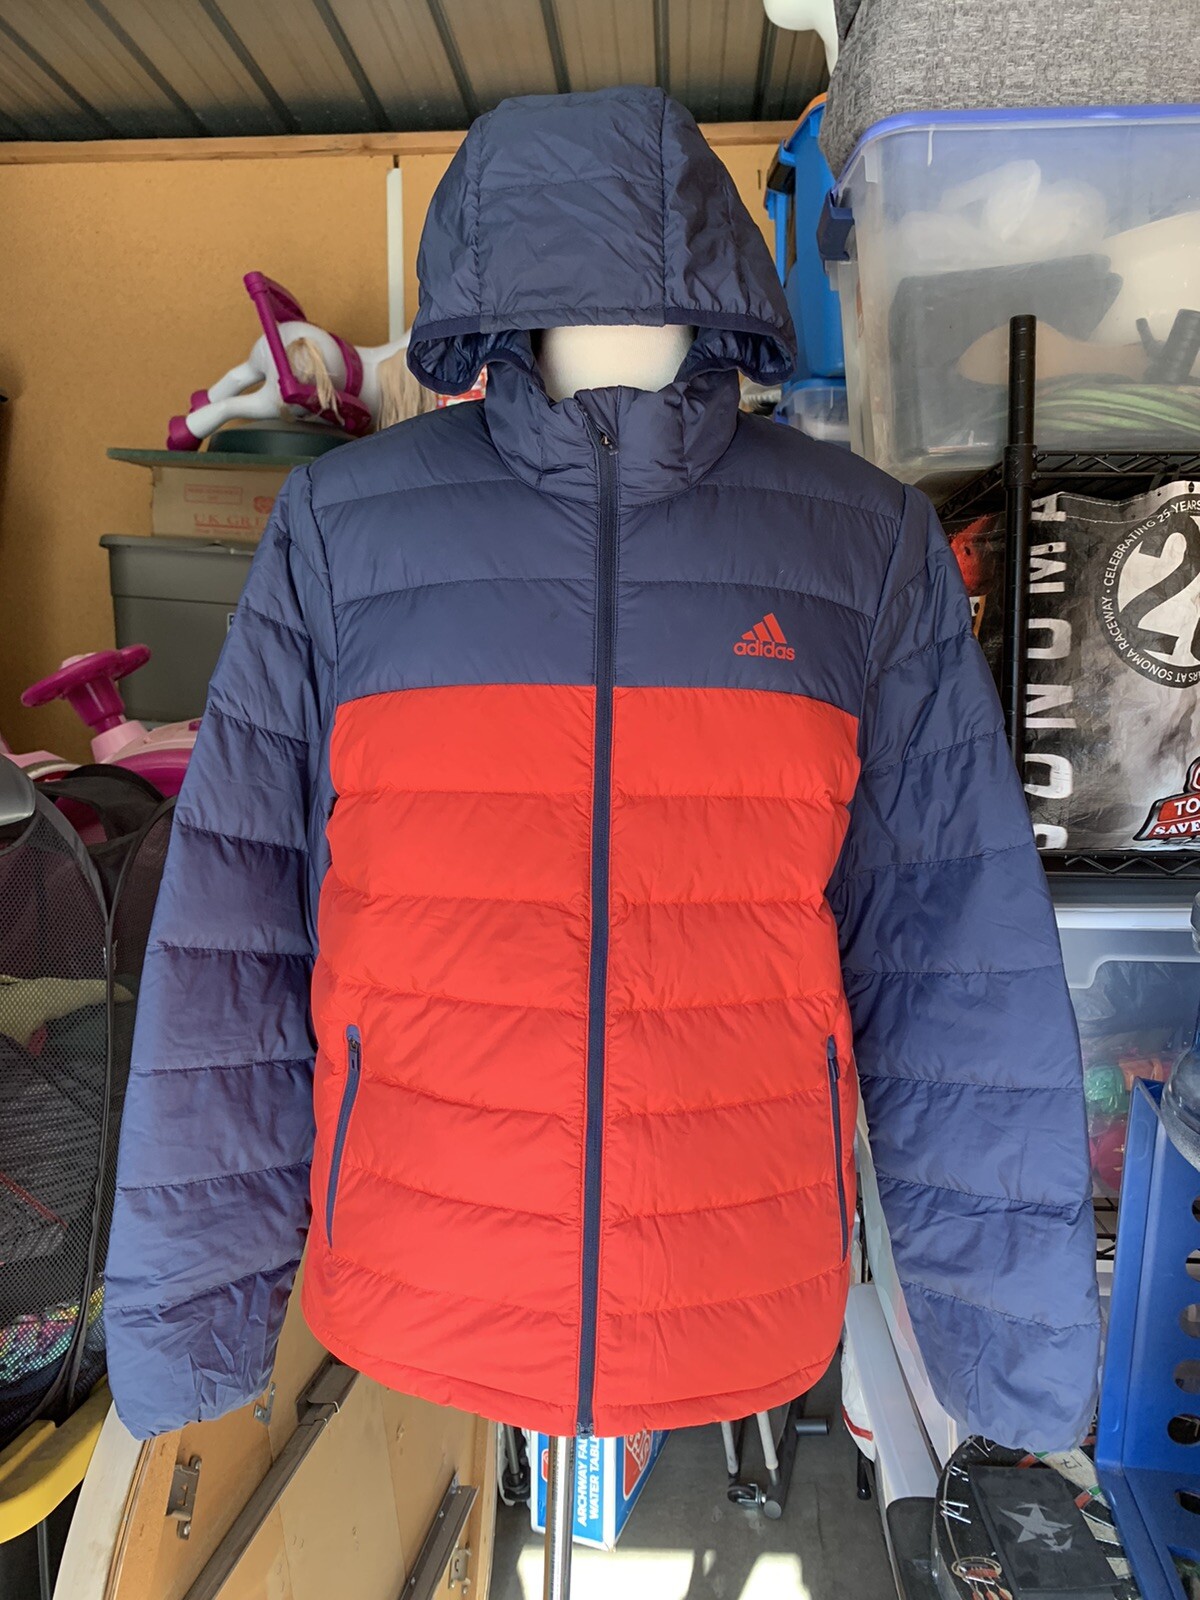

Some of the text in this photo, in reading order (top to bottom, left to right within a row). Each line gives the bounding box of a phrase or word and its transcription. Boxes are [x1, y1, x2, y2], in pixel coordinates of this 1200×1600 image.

[1103, 499, 1200, 586] CELEBRATING 25 YEARS
[1101, 596, 1130, 651] RACEWAY
[733, 640, 796, 661] adidas
[1126, 648, 1174, 681] SONOMA
[1174, 672, 1187, 683] AT
[577, 1461, 588, 1527] ARCHWAY
[589, 1475, 600, 1520] WATER
